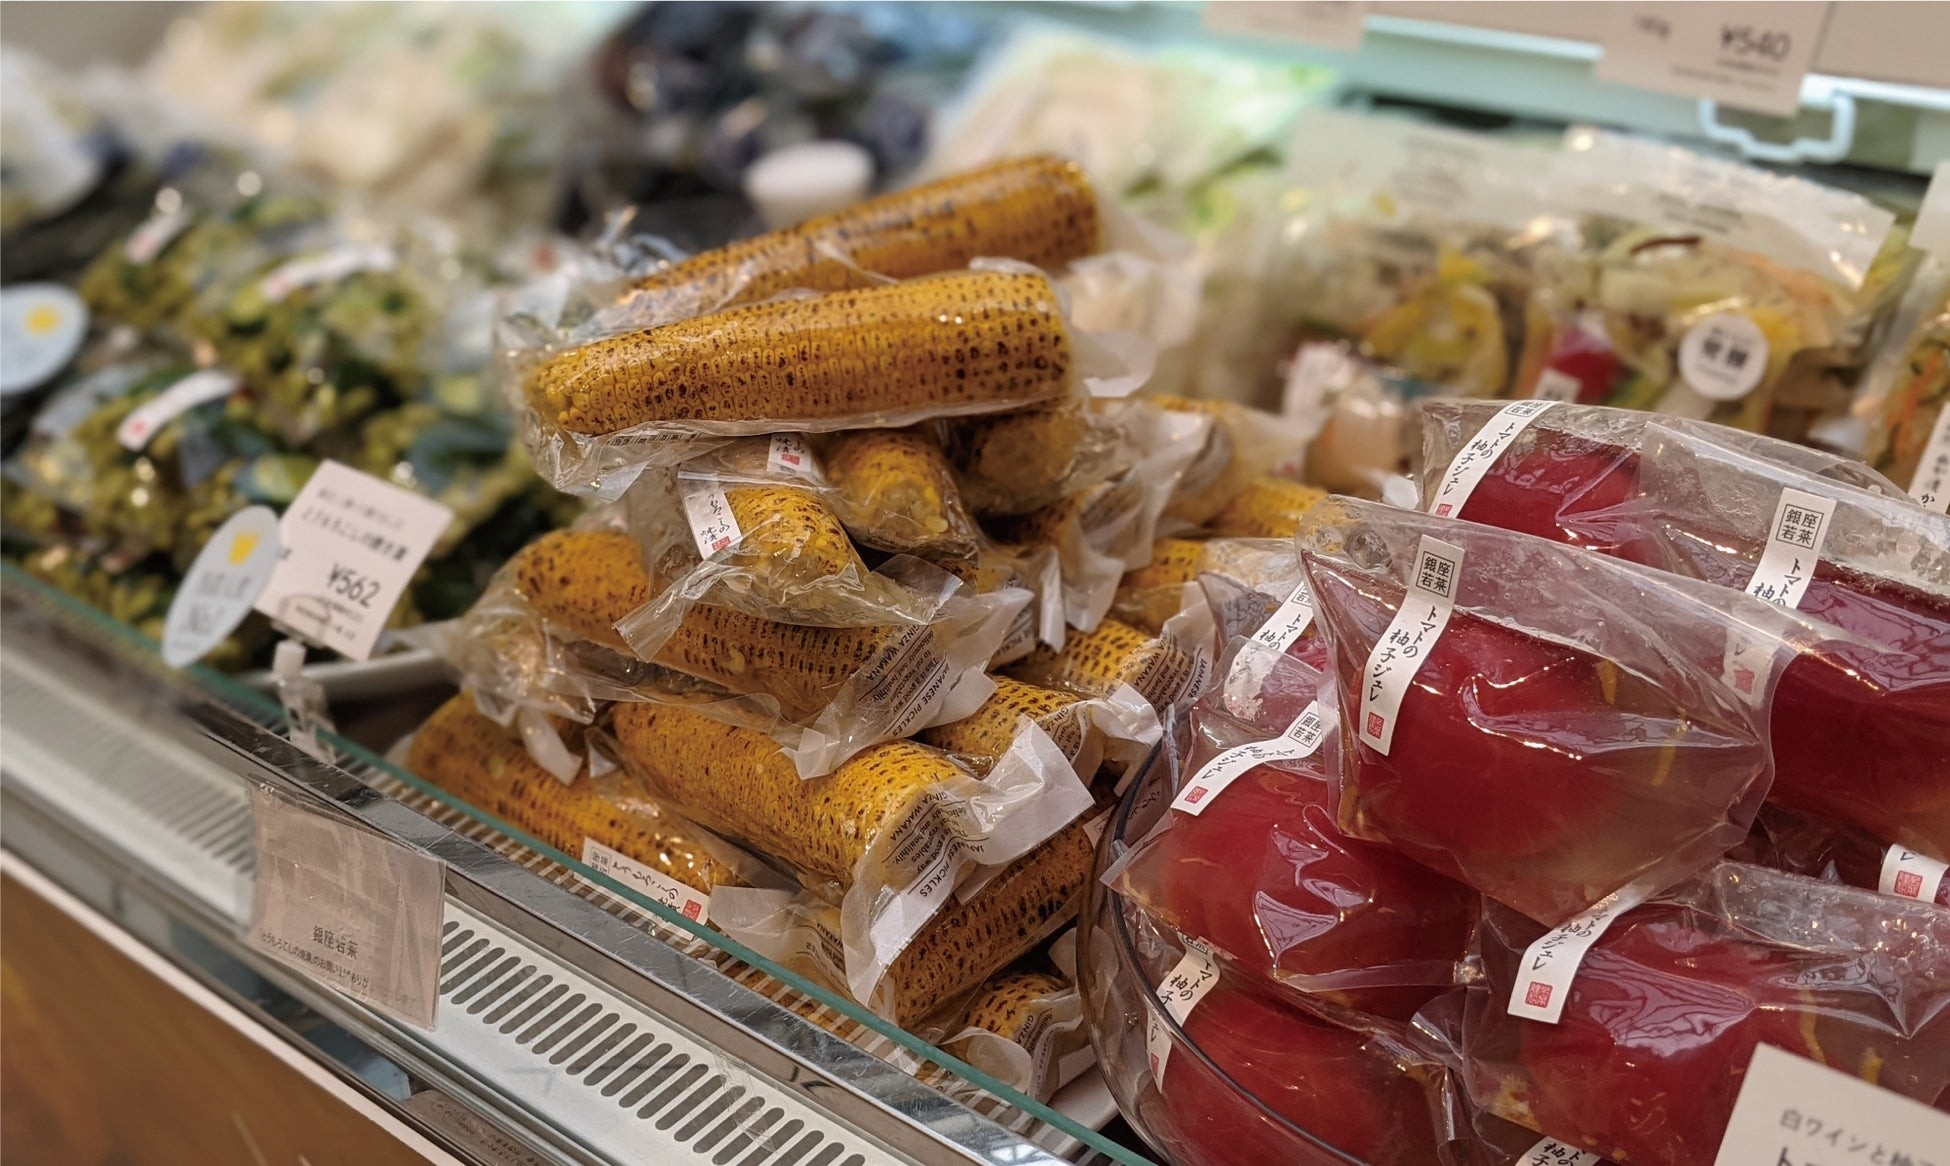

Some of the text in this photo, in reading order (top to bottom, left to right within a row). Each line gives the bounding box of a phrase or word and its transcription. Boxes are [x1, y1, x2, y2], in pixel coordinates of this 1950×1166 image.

[1721, 24, 1792, 62] ¥540
[1782, 524, 1815, 545] 若菜
[1785, 508, 1819, 529] 銀座
[1421, 571, 1449, 595] 若菜
[1424, 556, 1451, 579] 銀座
[327, 563, 381, 609] ¥562
[1402, 605, 1436, 658] トマトの
[866, 647, 898, 681] WAKANA
[1369, 628, 1410, 702] 柚子ジュレ
[891, 703, 921, 737] PICKLES
[1044, 705, 1069, 733] GINZA
[890, 805, 922, 841] WAKANA
[919, 861, 950, 897] PICKLES
[1178, 957, 1213, 1001] トマトの
